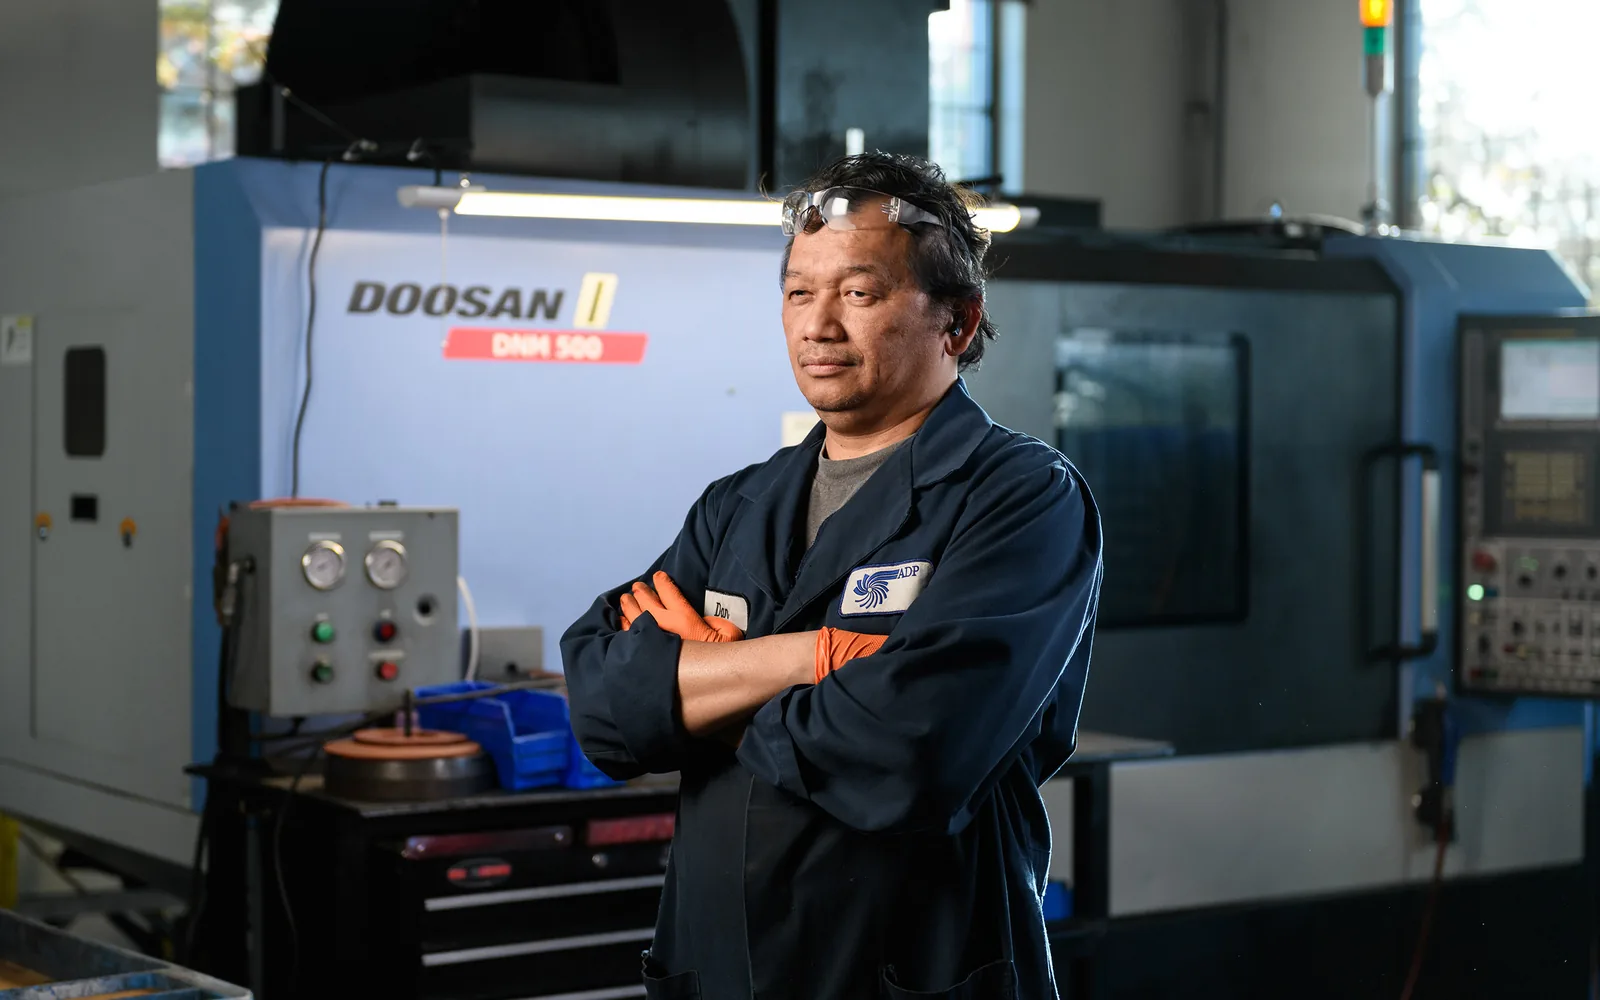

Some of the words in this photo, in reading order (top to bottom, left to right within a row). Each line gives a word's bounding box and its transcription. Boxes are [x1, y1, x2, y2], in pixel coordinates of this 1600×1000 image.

[347, 281, 565, 320] DOOSAN
[492, 332, 550, 358] DNM
[555, 334, 604, 360] 500
[897, 565, 920, 580] ADP
[714, 602, 730, 619] Dan
